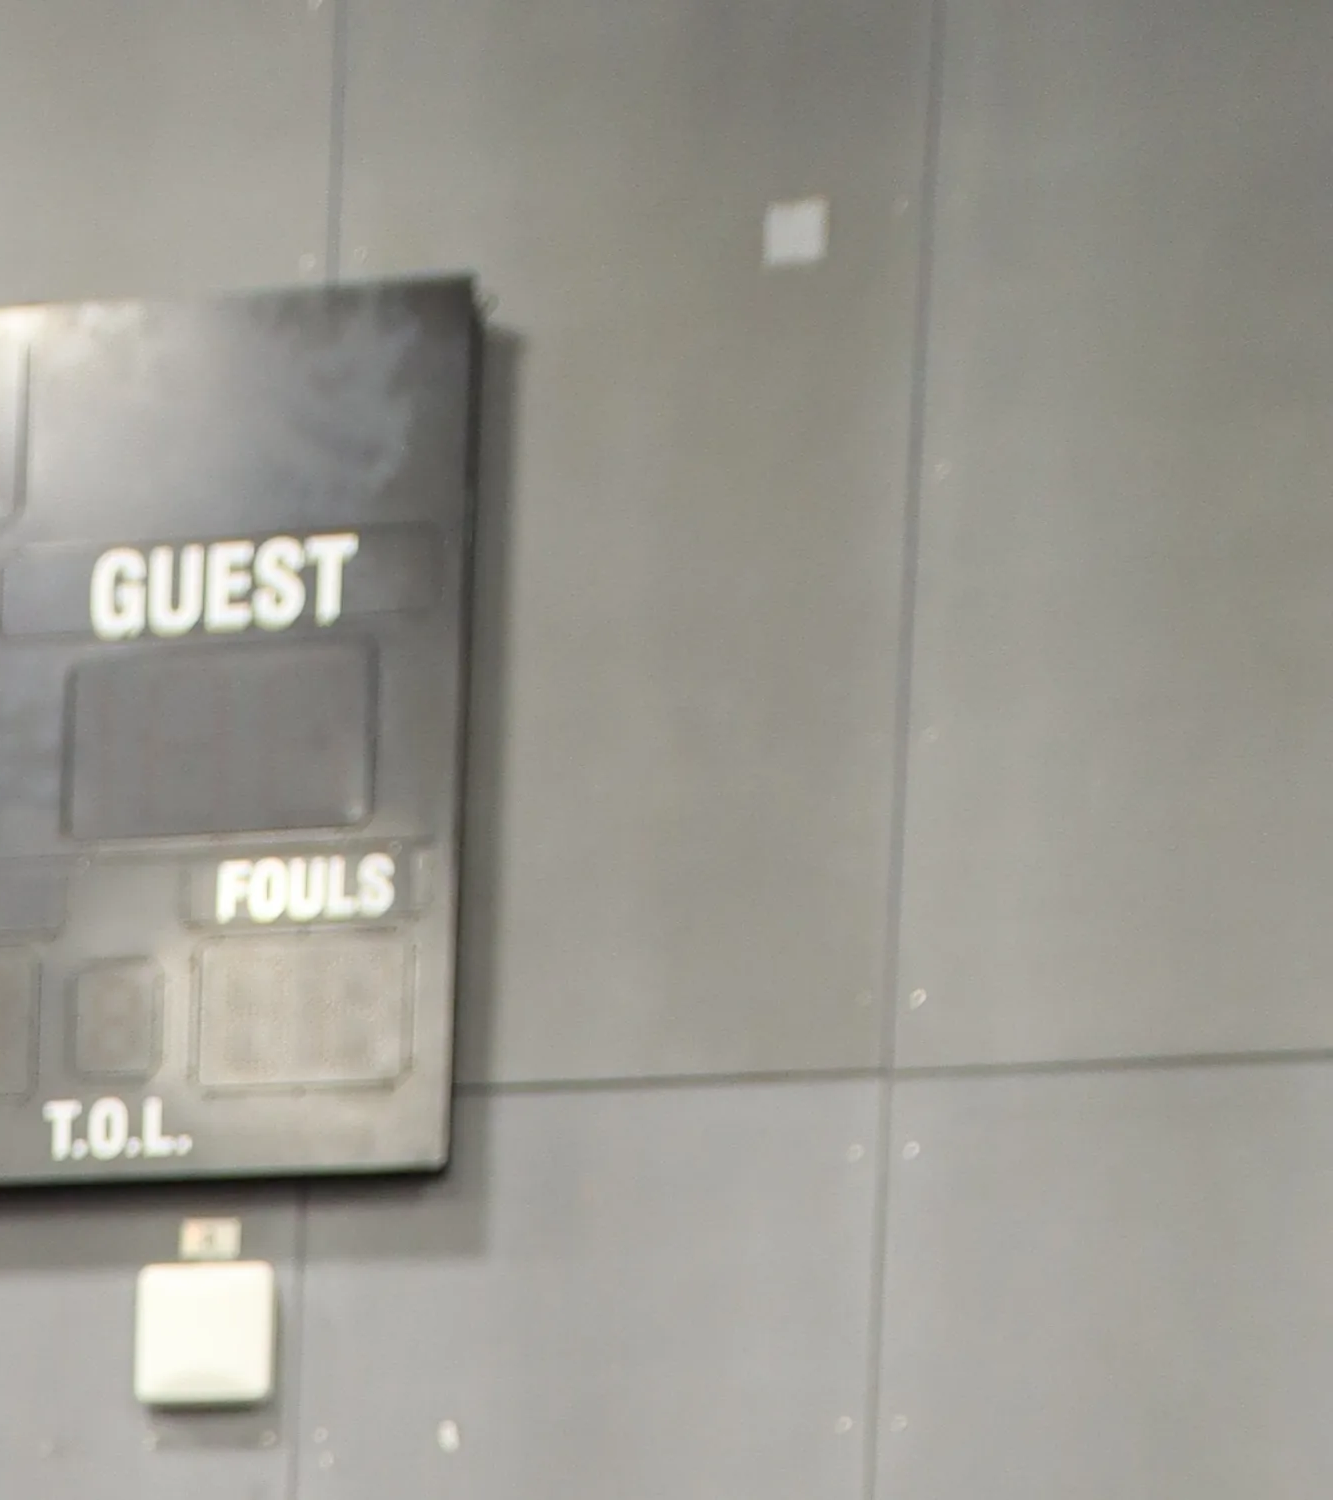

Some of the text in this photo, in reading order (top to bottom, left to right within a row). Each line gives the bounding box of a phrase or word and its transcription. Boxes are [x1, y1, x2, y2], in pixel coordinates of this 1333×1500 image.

[90, 535, 358, 638] GUEST
[214, 853, 395, 923] FOULS
[44, 1097, 194, 1161] T.O.L.
